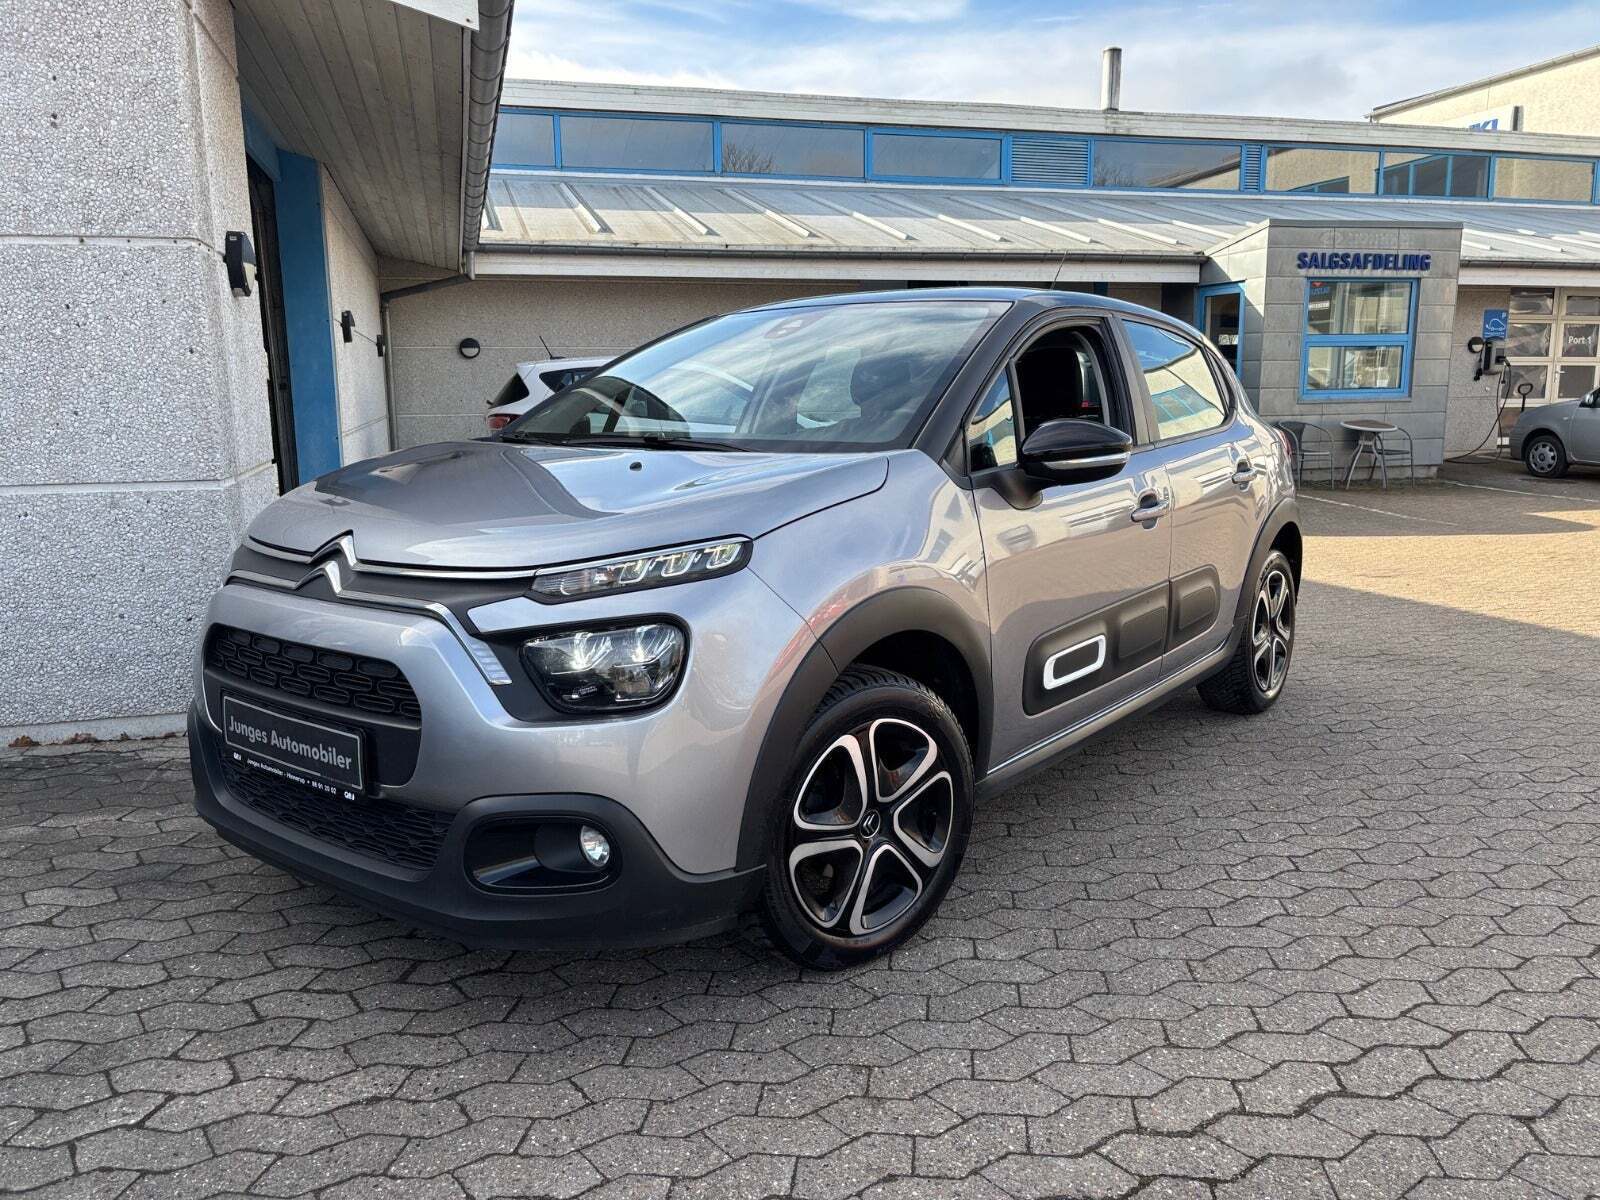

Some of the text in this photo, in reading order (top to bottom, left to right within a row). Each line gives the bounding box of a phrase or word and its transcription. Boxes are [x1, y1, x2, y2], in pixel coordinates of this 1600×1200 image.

[1297, 252, 1431, 271] SALGSAFDELING
[1568, 336, 1592, 344] Port 1
[229, 715, 351, 769] Junges Automobiler
